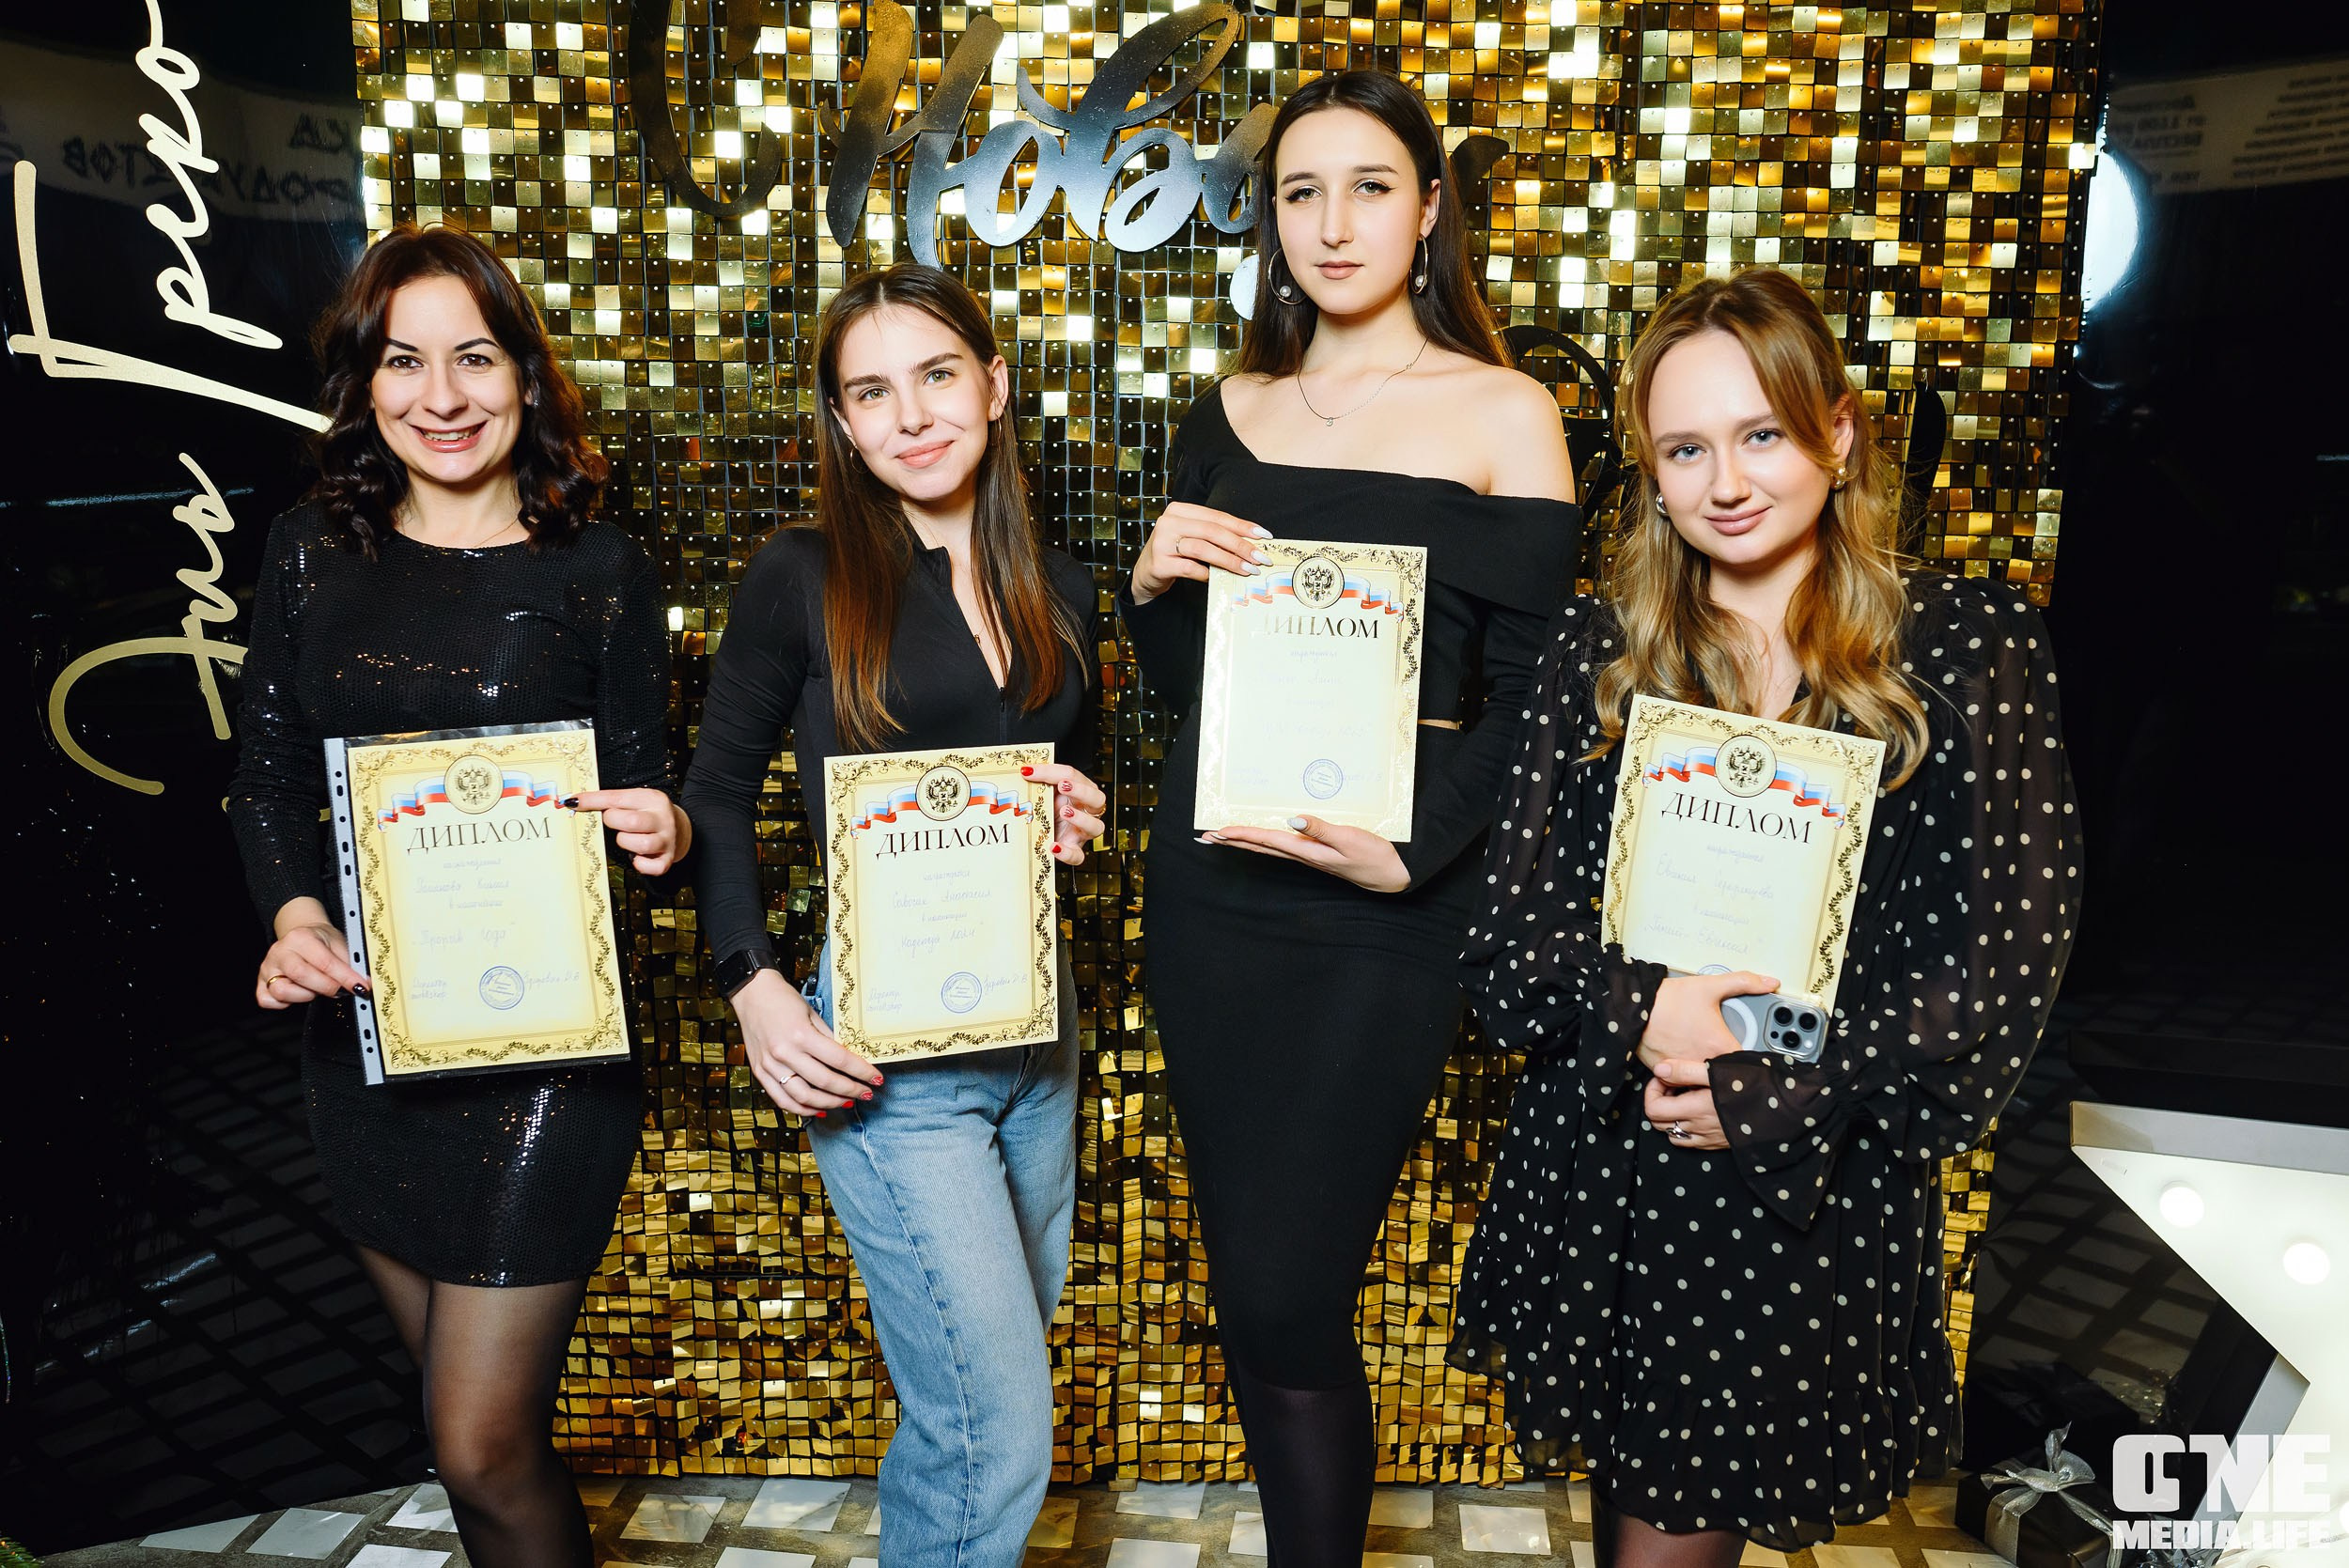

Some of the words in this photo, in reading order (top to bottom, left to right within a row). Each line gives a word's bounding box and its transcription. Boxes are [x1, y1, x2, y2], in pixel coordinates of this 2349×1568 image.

[407, 816, 552, 856] ДИПЛОМ
[1661, 791, 1812, 844] ДИПЛОМ
[876, 823, 1010, 860] ДИПЛОМ
